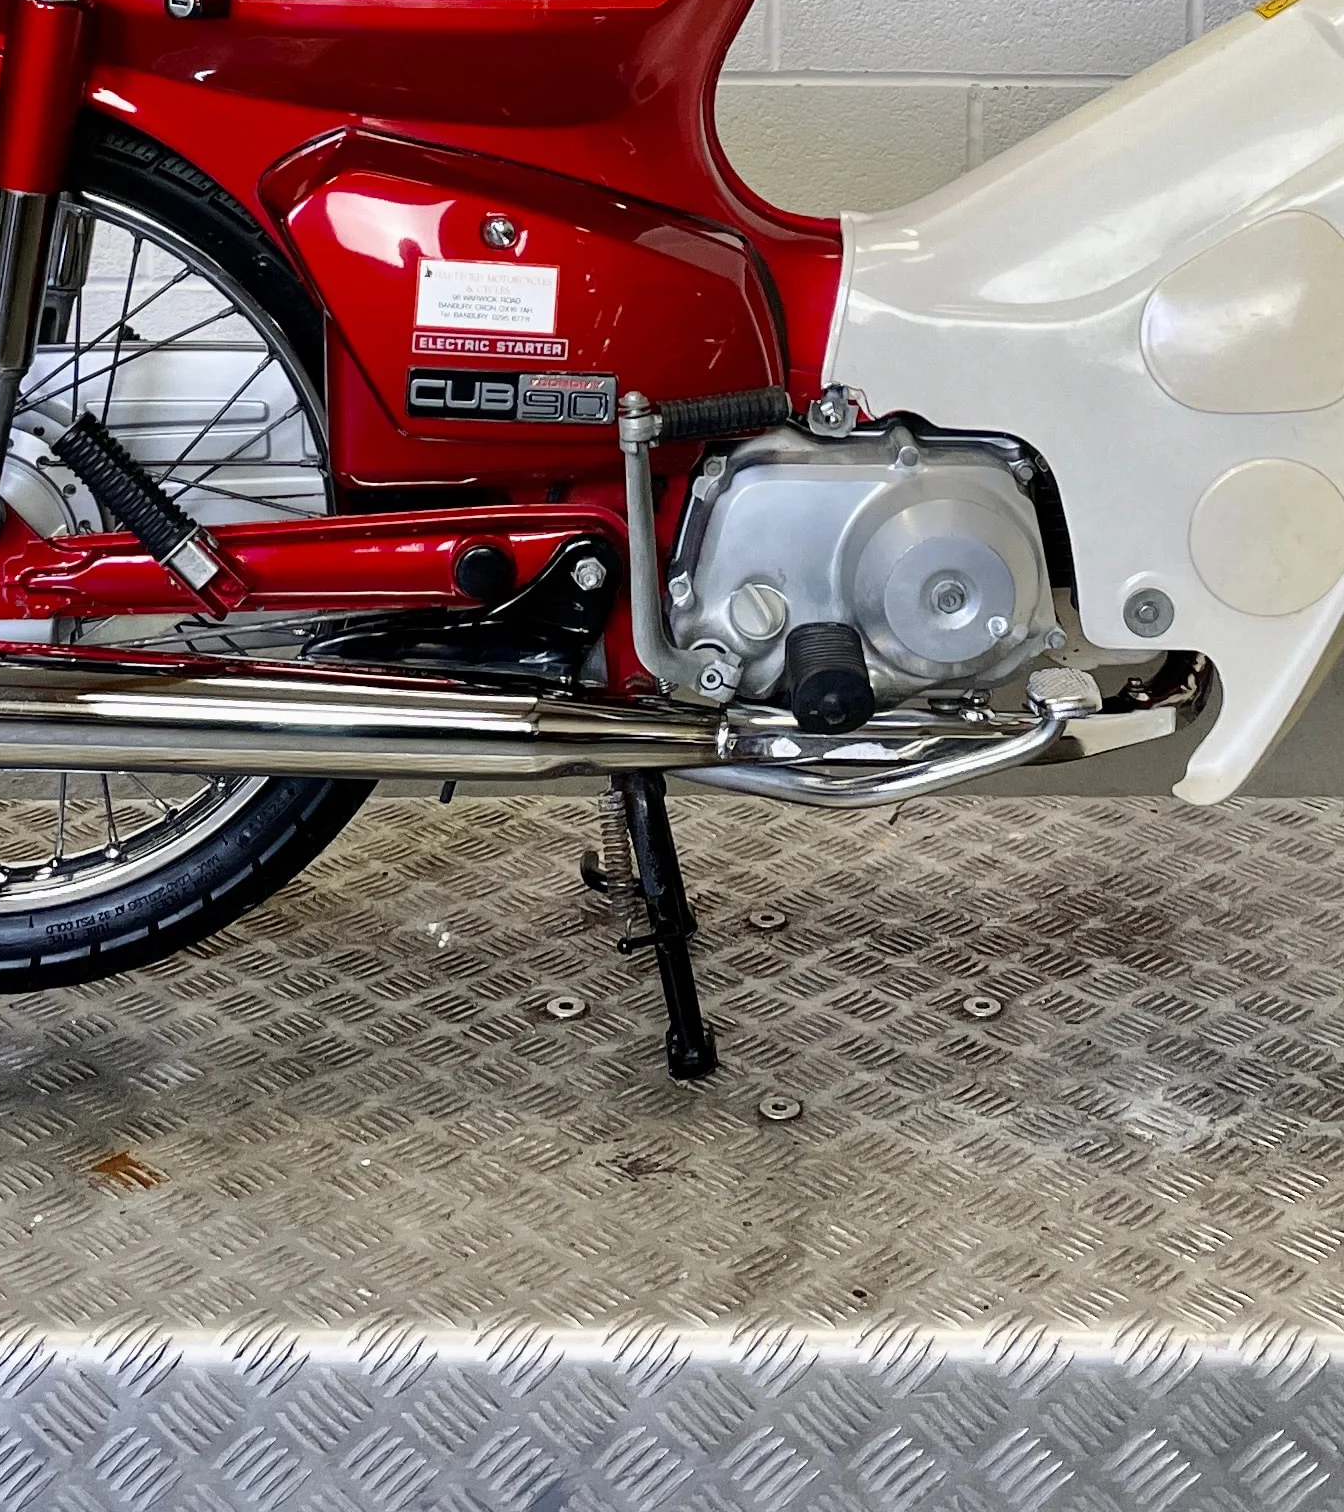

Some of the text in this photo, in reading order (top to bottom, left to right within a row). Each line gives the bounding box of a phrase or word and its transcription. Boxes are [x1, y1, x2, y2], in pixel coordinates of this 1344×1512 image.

[500, 296, 522, 304] ROAD
[419, 337, 562, 356] ELECTRIC STARTER
[410, 378, 610, 422] CUB 90
[45, 920, 74, 933] COLD
